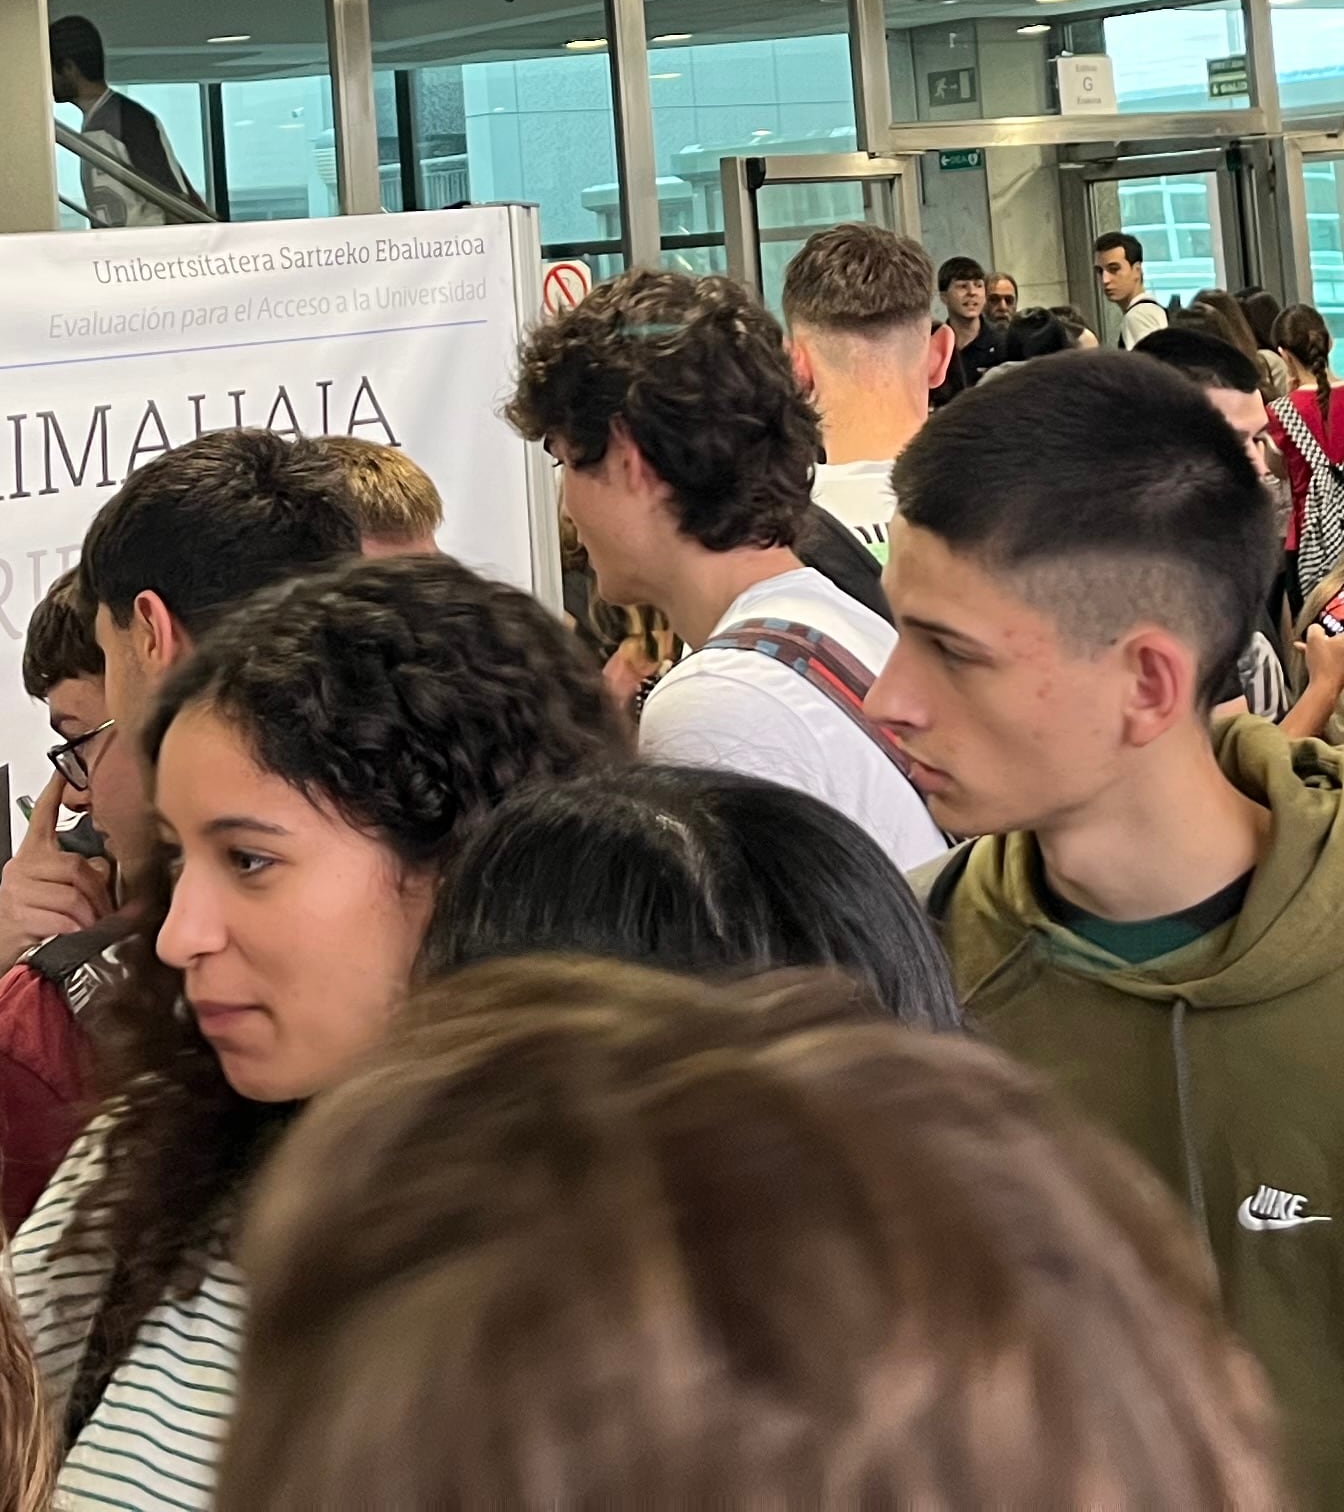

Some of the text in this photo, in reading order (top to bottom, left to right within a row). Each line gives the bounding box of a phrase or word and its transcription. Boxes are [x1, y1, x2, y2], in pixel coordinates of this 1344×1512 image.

[1082, 76, 1094, 92] G
[92, 234, 485, 284] Unibertsitatera Sartzeko Ebaluazioa
[48, 278, 487, 340] Evaluación para el Acceso a la Universidad
[1250, 1184, 1308, 1220] NIKE
